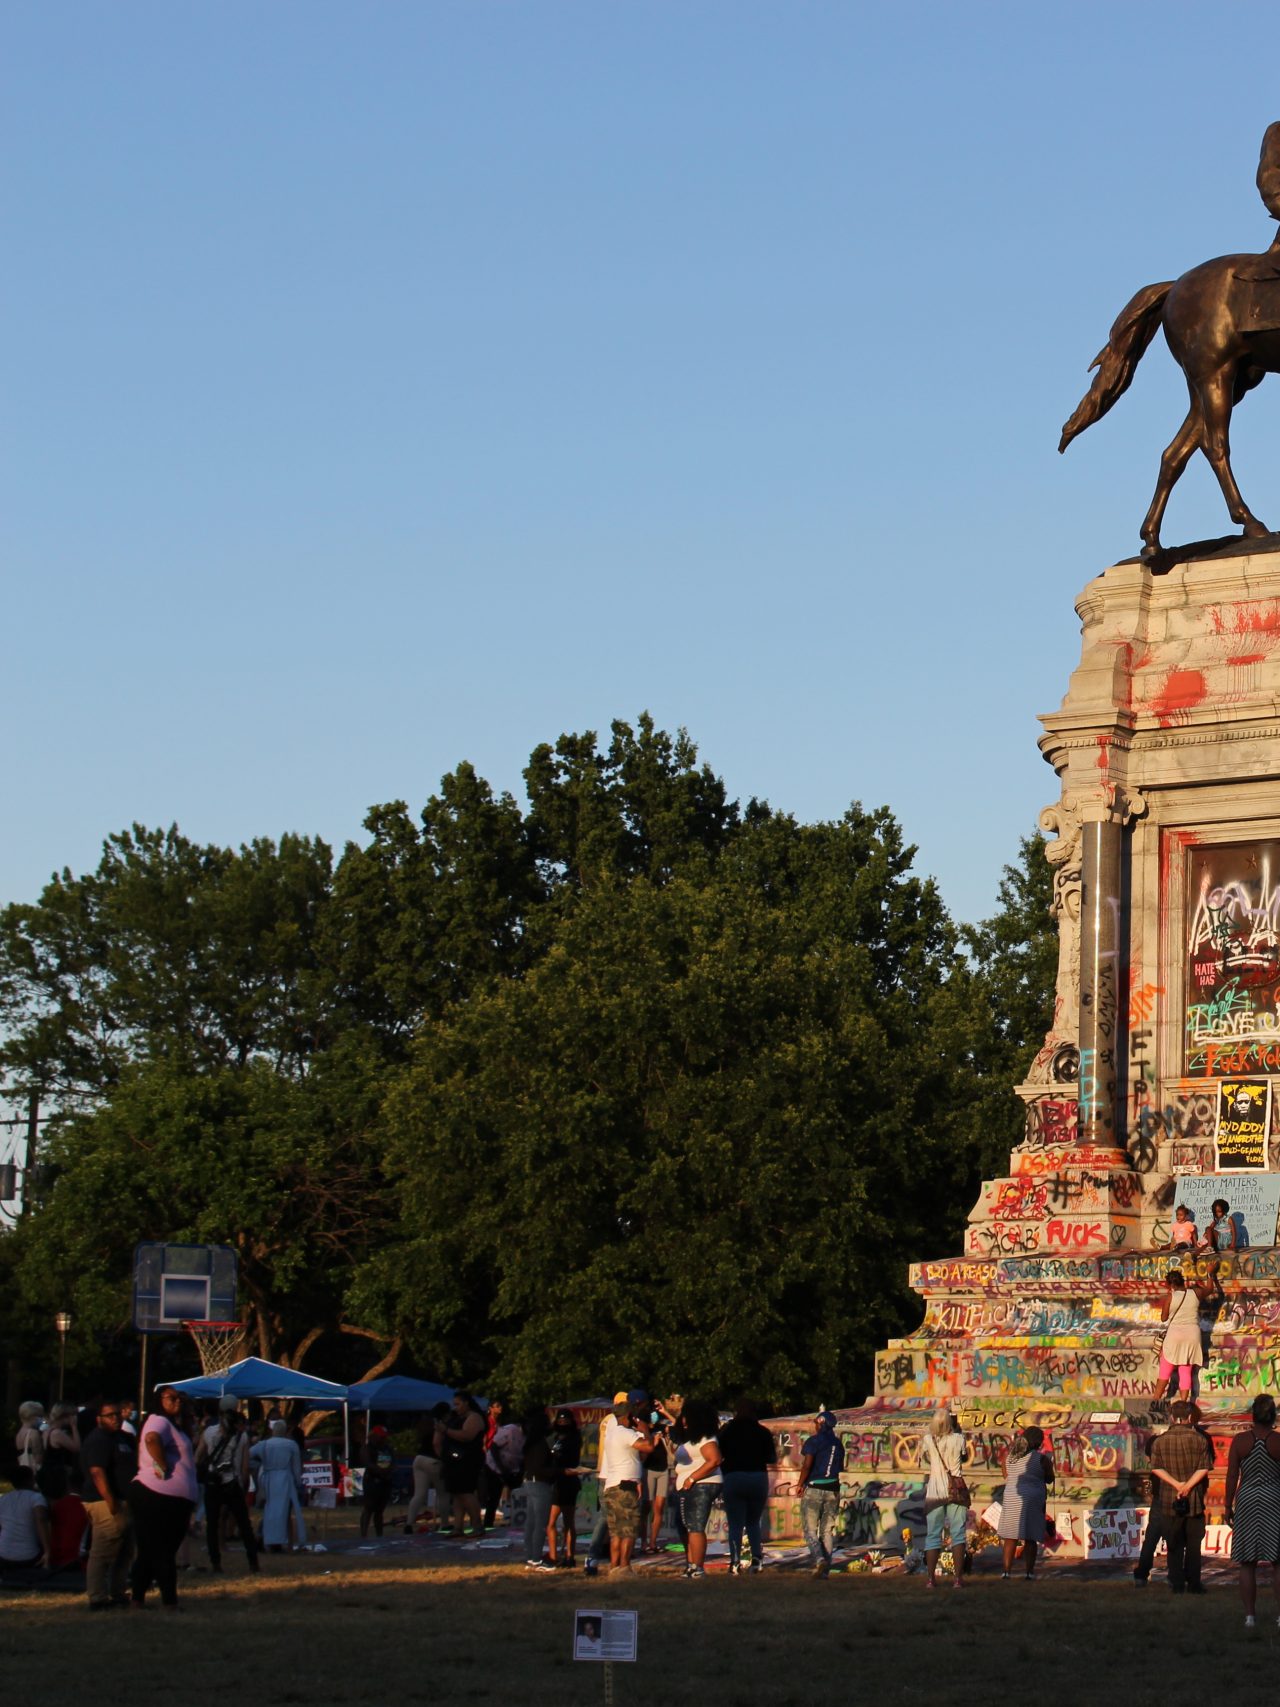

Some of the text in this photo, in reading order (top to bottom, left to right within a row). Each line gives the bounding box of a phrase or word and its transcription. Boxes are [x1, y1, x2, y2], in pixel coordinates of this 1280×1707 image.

[1195, 963, 1216, 976] HATE
[1200, 975, 1215, 986] HAS
[1183, 1177, 1258, 1190] HISTORY MATTERS
[1231, 1194, 1260, 1205] HUMAN
[1250, 1203, 1275, 1213] RACISM
[1046, 1219, 1108, 1248] FUCK
[778, 1433, 794, 1448] 12
[1088, 1510, 1118, 1529] GET
[1088, 1530, 1122, 1550] STAND
